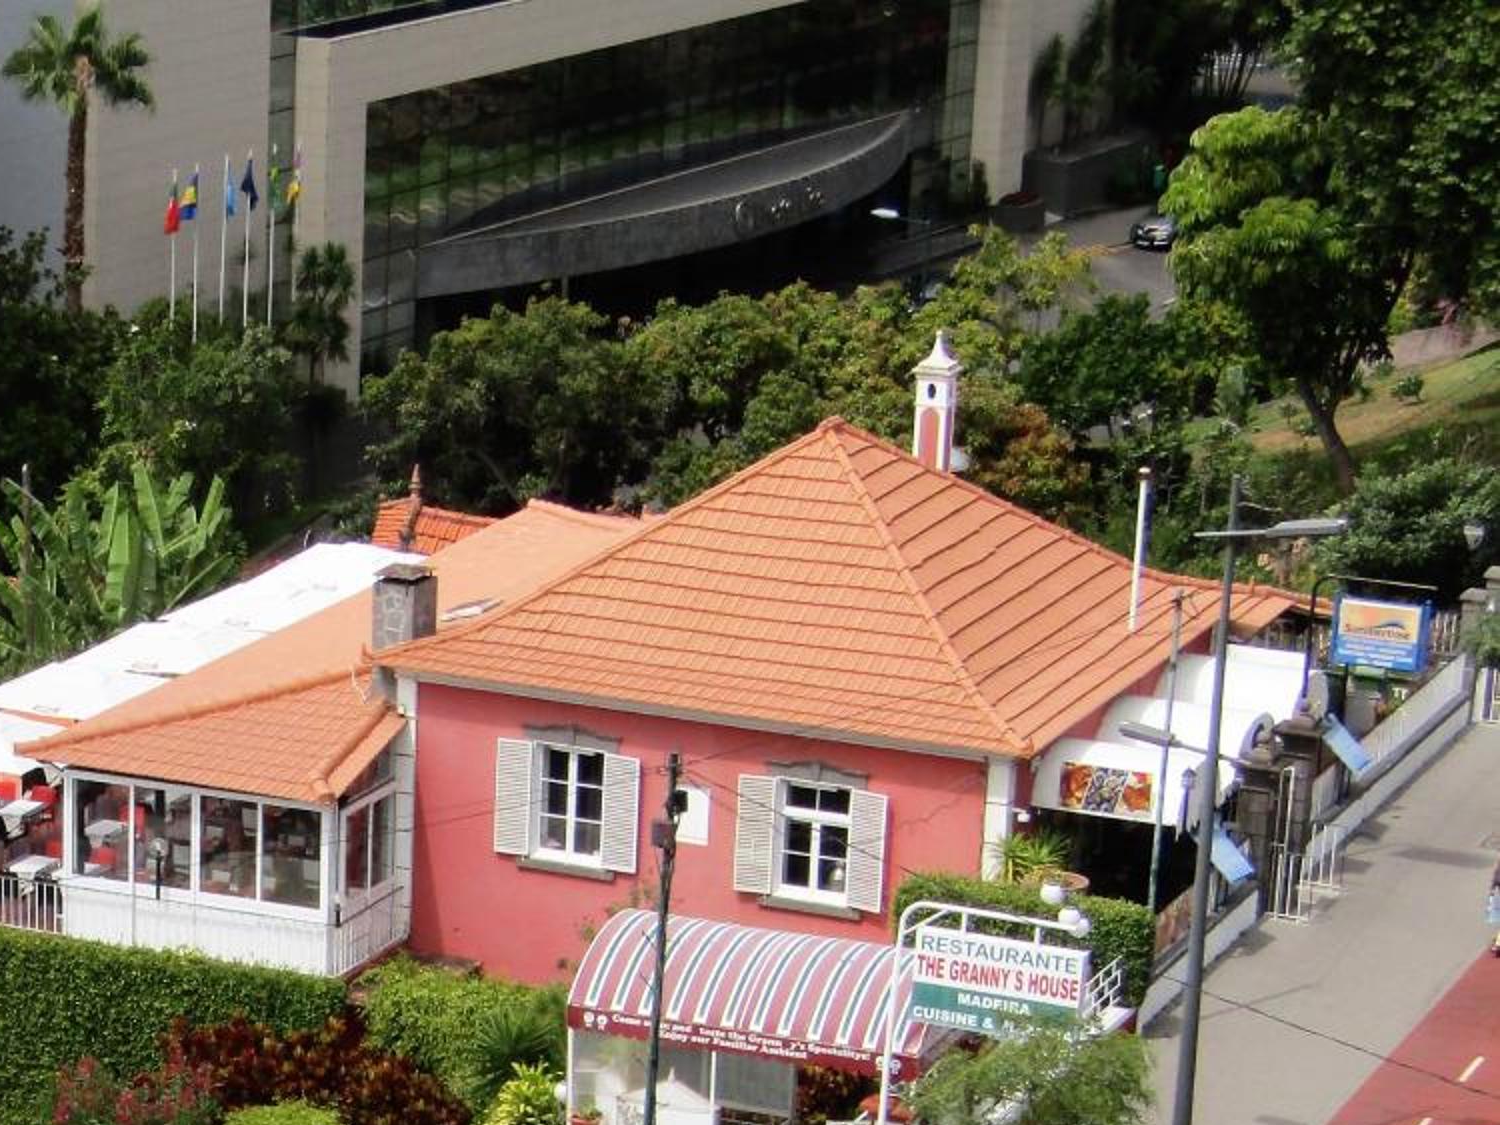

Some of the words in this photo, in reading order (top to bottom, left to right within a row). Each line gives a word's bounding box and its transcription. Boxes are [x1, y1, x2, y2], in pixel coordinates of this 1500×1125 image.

[922, 935, 1077, 975] RESTAURANTE
[917, 954, 945, 979] THE
[1028, 973, 1079, 1001] HOUSE
[913, 1005, 977, 1027] CUISINE
[982, 1016, 995, 1029] &
[957, 992, 1031, 1015] MADEIRA
